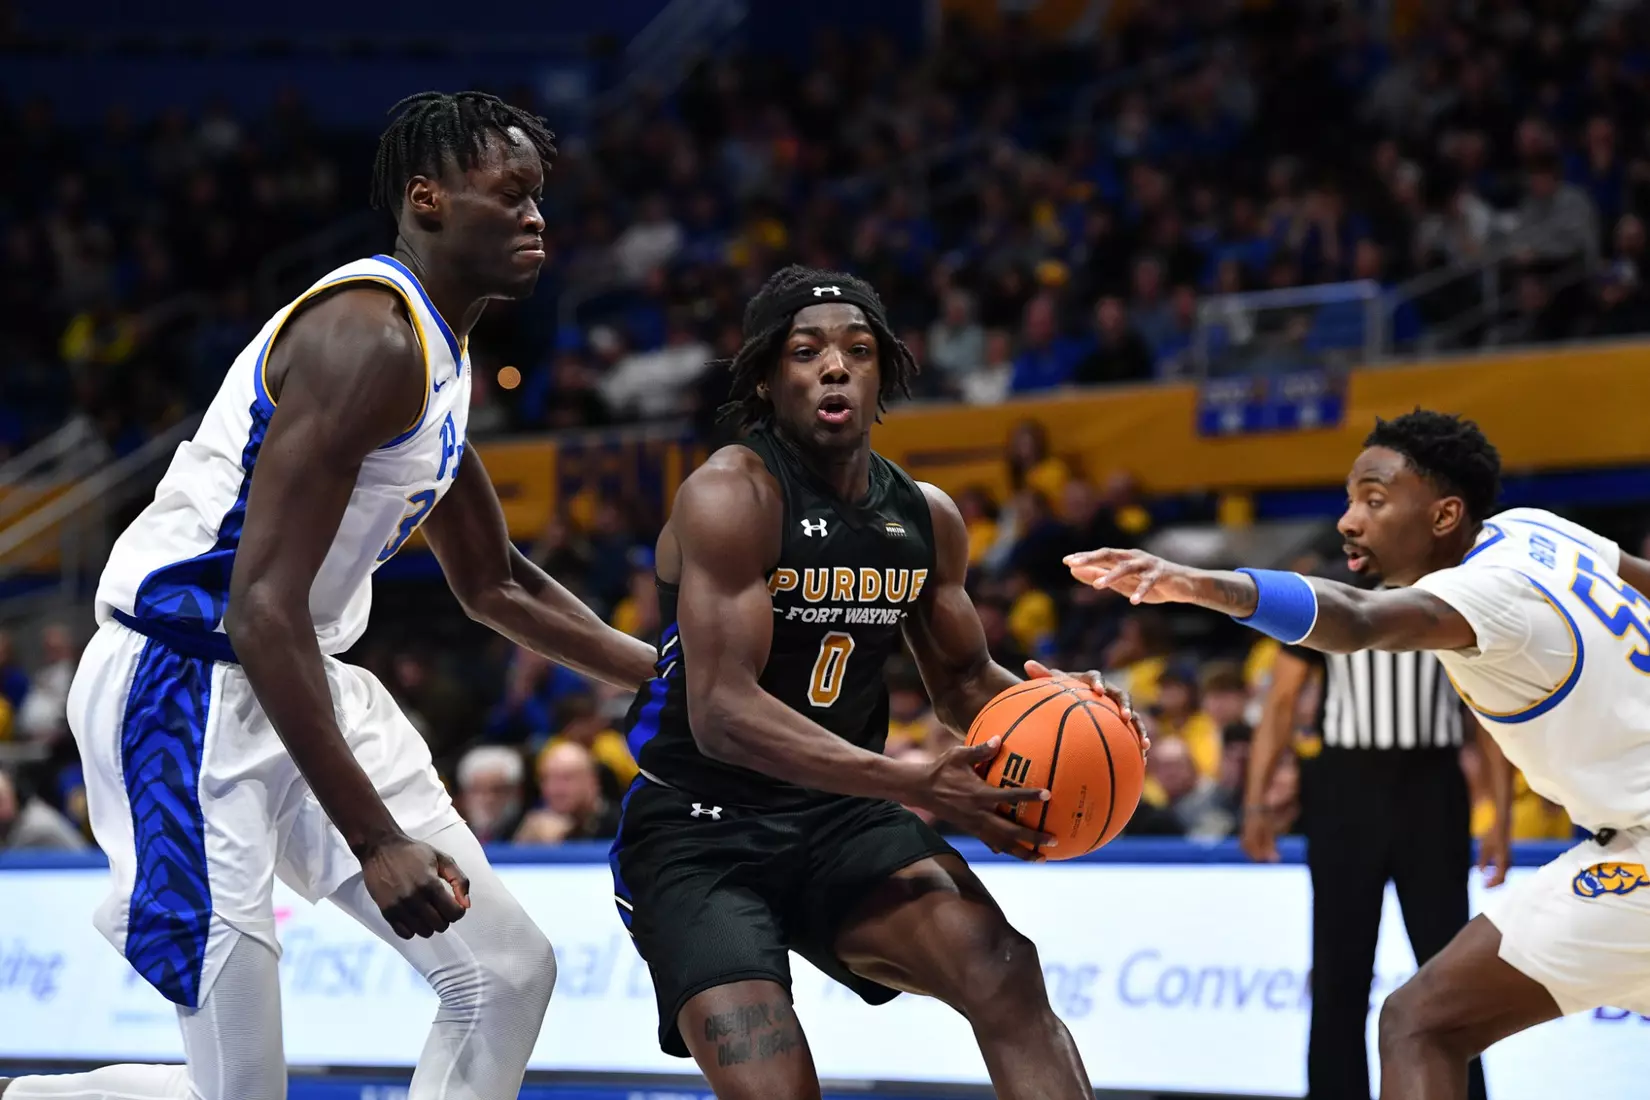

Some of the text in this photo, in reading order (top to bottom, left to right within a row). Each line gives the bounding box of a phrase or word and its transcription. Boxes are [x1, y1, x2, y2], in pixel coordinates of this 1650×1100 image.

[767, 566, 929, 603] PURDUE
[785, 606, 902, 625] FORT WAYNE
[807, 630, 856, 708] 0
